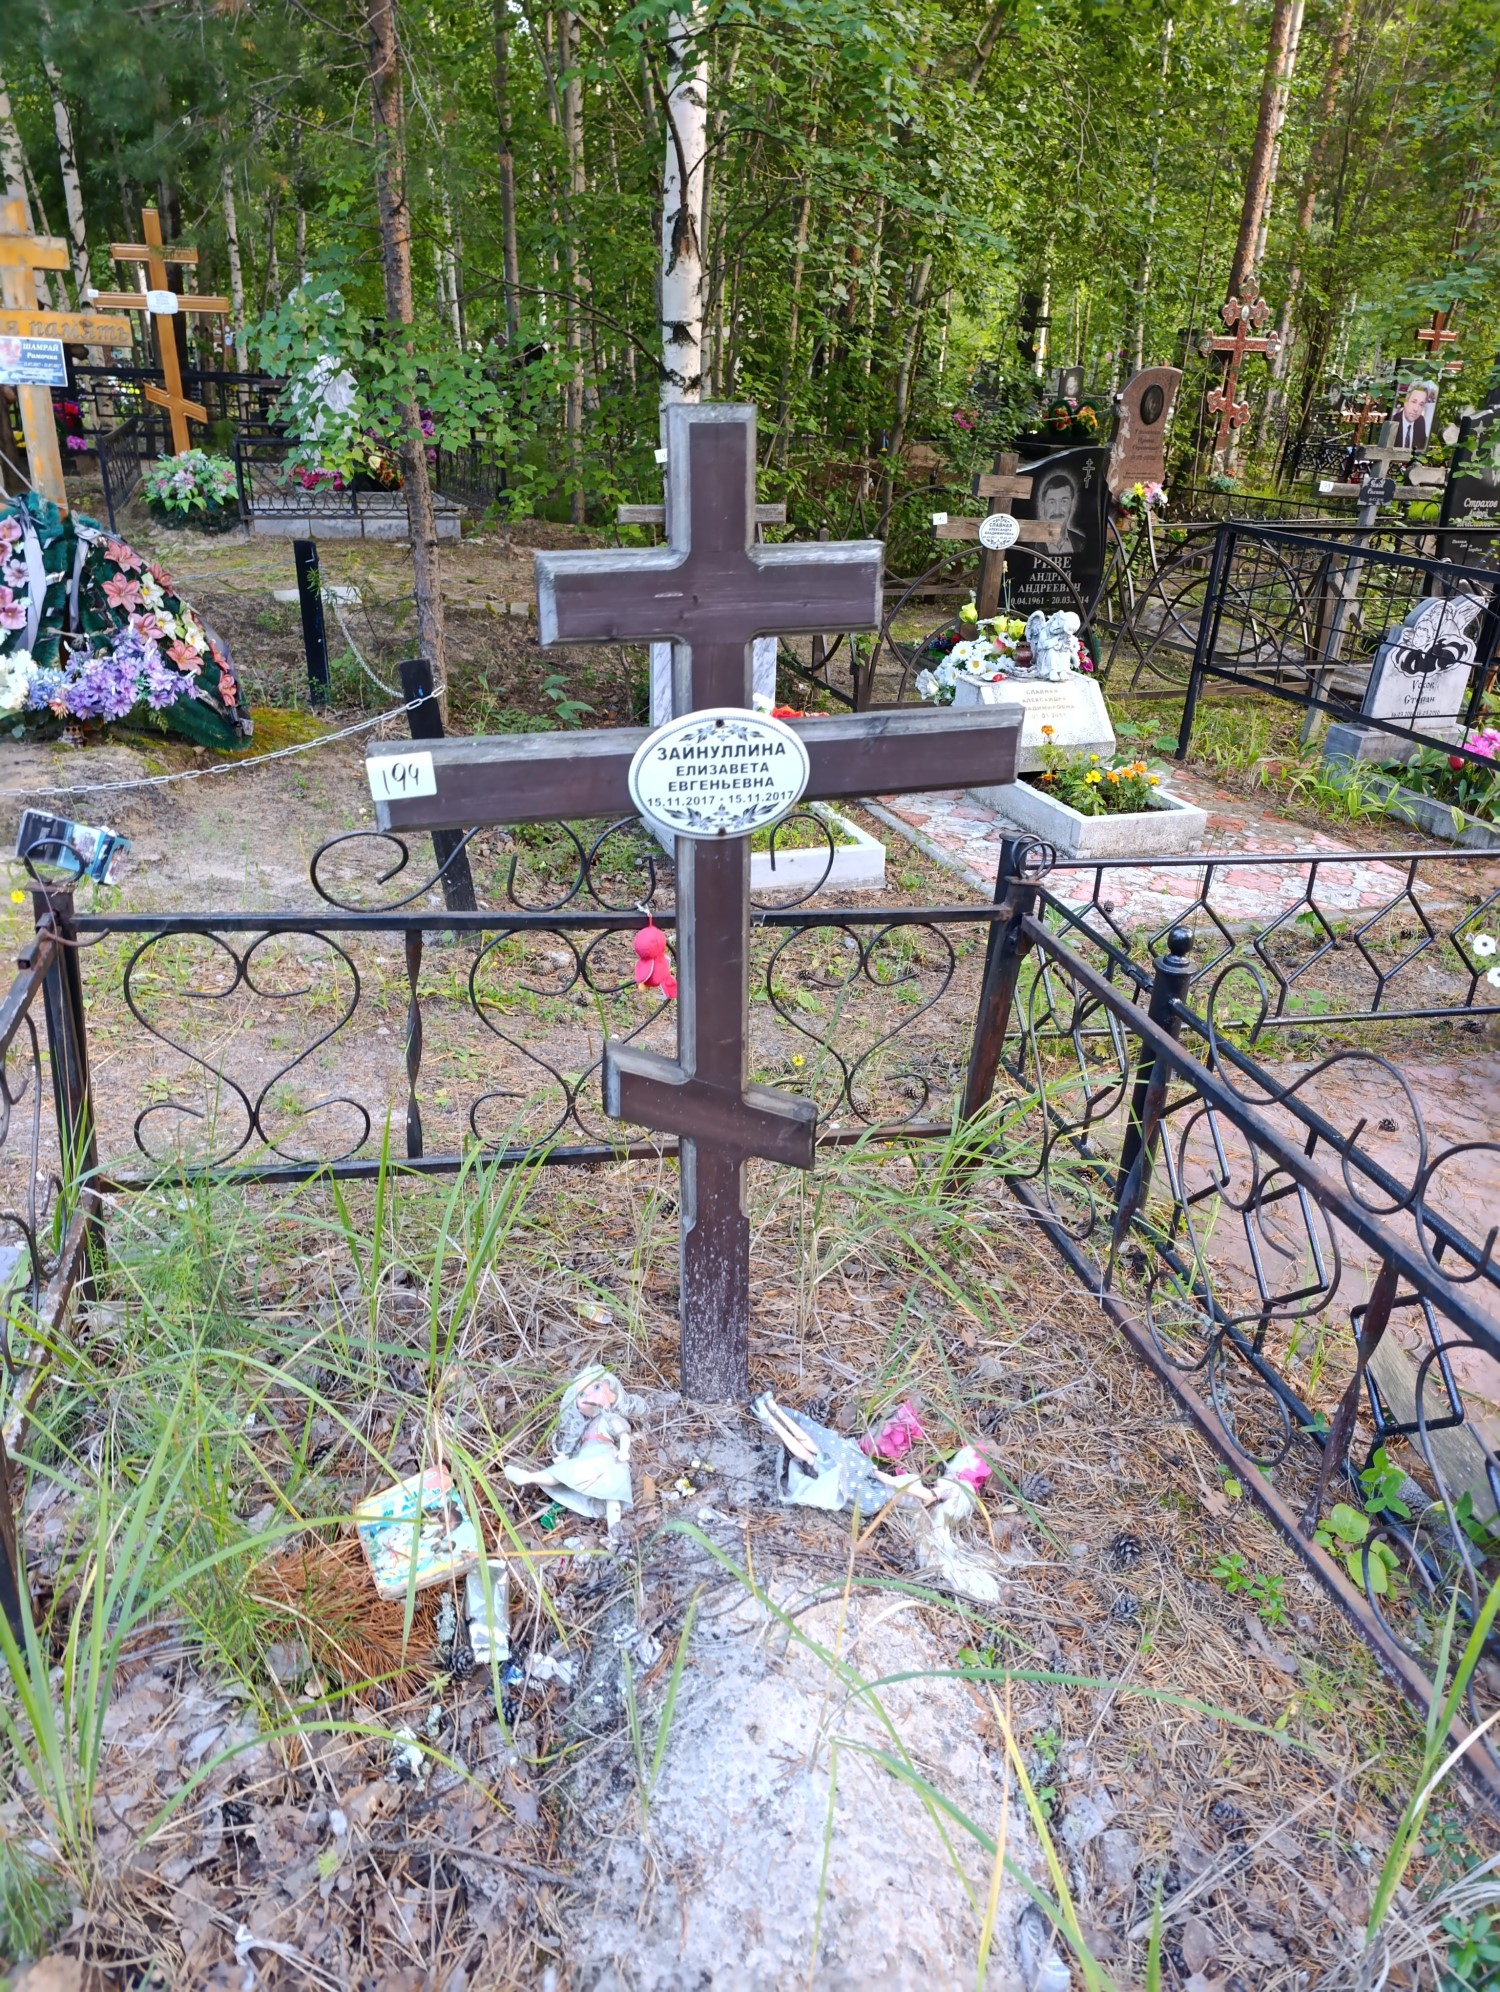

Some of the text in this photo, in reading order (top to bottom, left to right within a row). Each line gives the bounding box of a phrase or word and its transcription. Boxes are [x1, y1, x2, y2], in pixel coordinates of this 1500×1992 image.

[22, 343, 59, 352] ШАМРАЙ
[1463, 497, 1499, 510] Страхов
[1018, 583, 1082, 593] АНДРЕЕВЧ
[1009, 597, 1044, 605] 0.04.1961
[1404, 694, 1435, 704] Стпан
[676, 762, 769, 777] ЕЛИЗАВЕТА
[382, 762, 419, 795] 194
[668, 776, 775, 792] ЕВГЕНЬЕВНА
[647, 795, 715, 808] 15.11.2017
[729, 790, 794, 804] 15.11.2017
